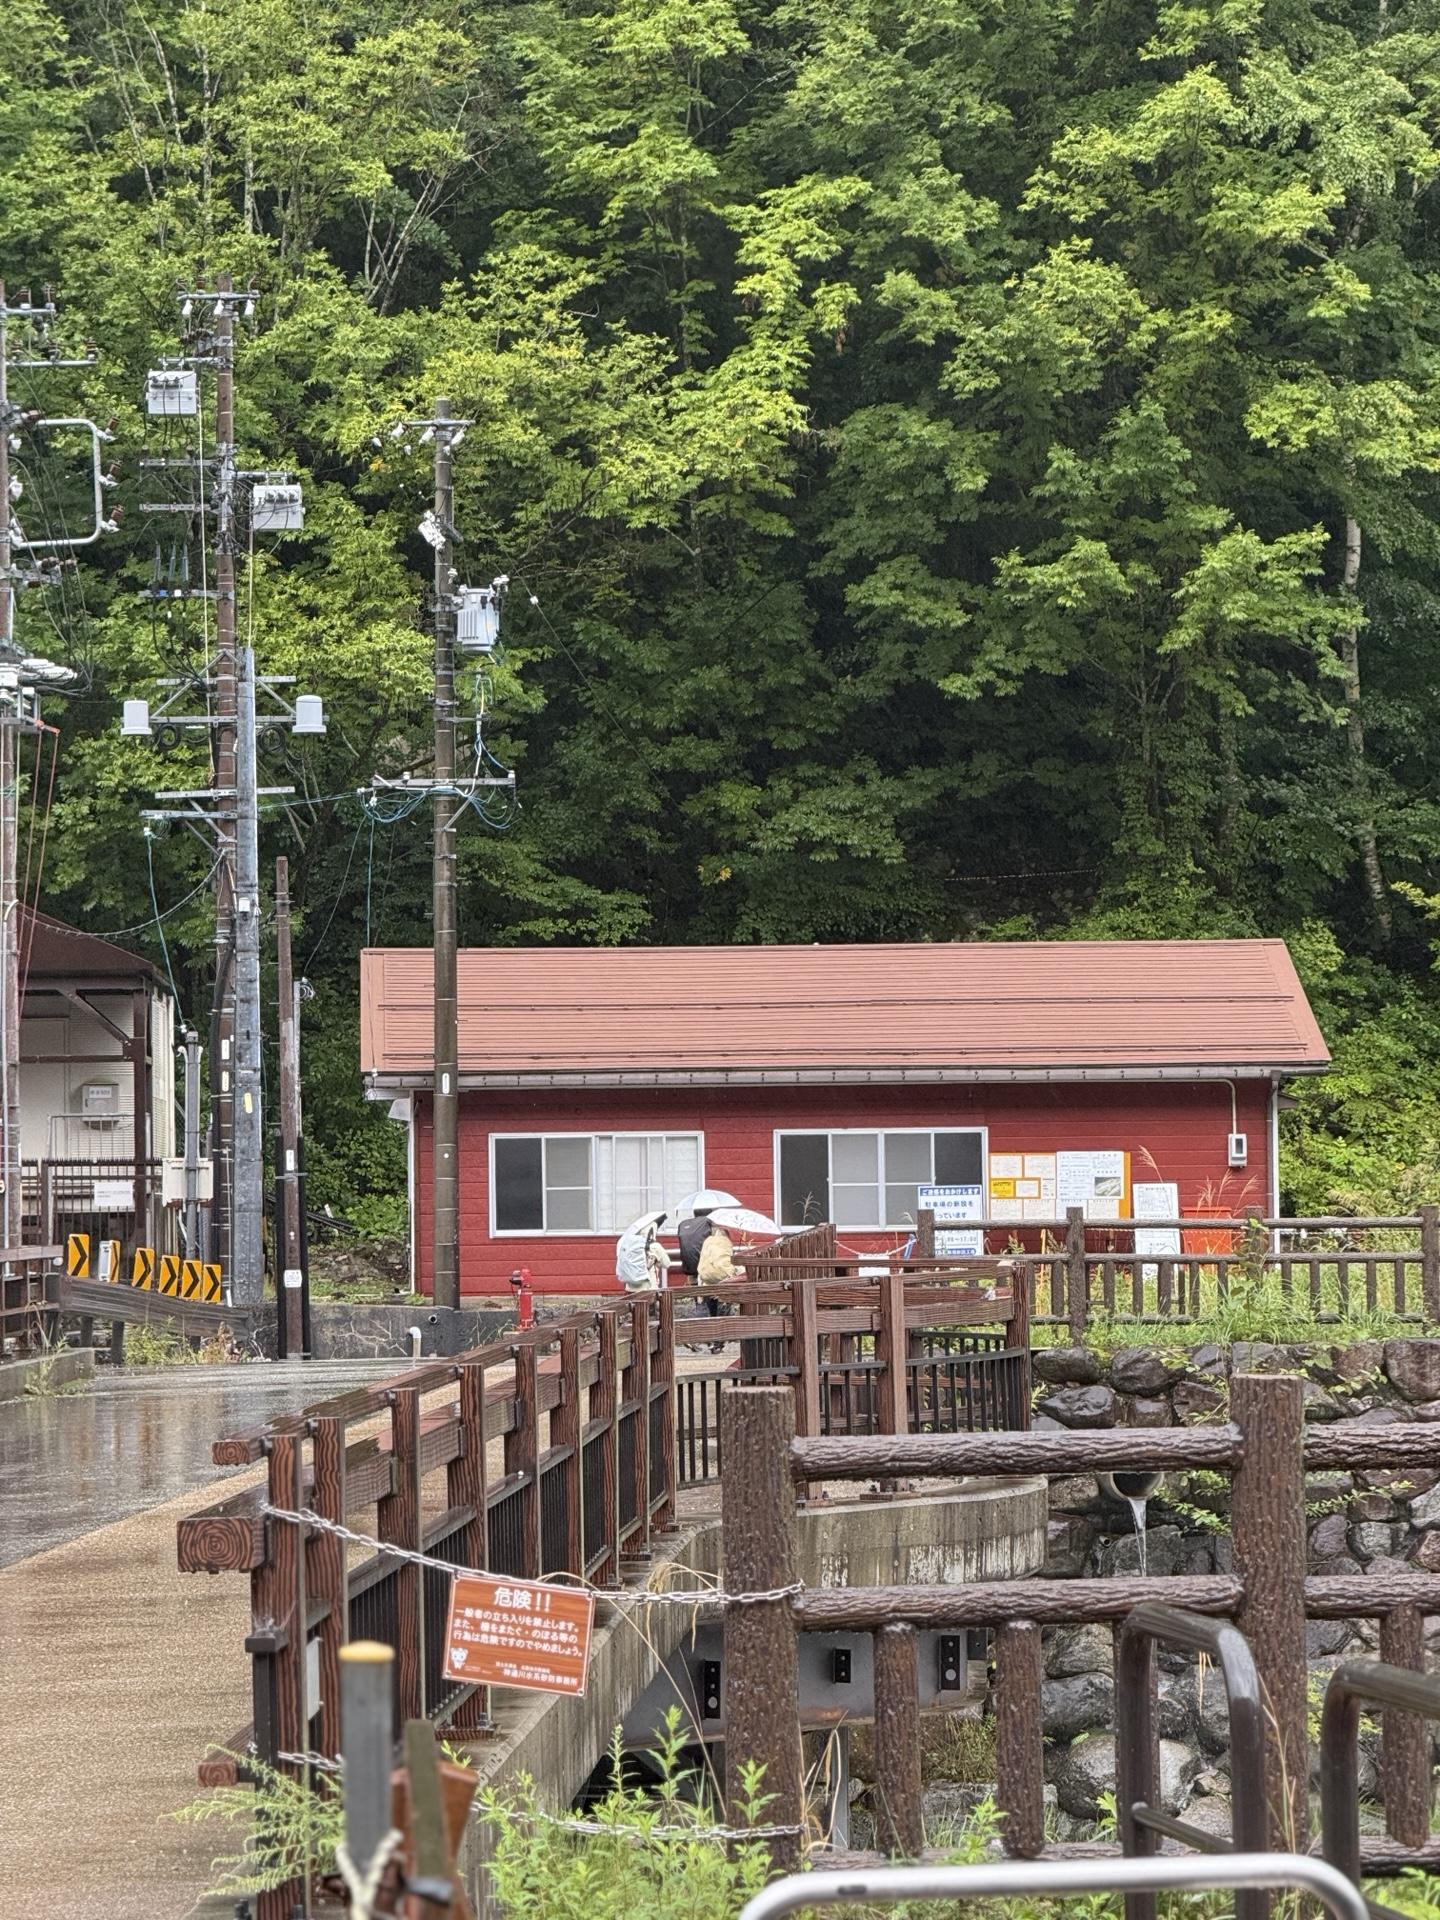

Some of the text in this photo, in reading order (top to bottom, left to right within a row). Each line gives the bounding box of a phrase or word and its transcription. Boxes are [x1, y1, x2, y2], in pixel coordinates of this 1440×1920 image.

[455, 1607, 580, 1633] 一般者の立ち入りを禁止します。
[453, 1630, 583, 1657] 行為は危険ですのでやめましょう。
